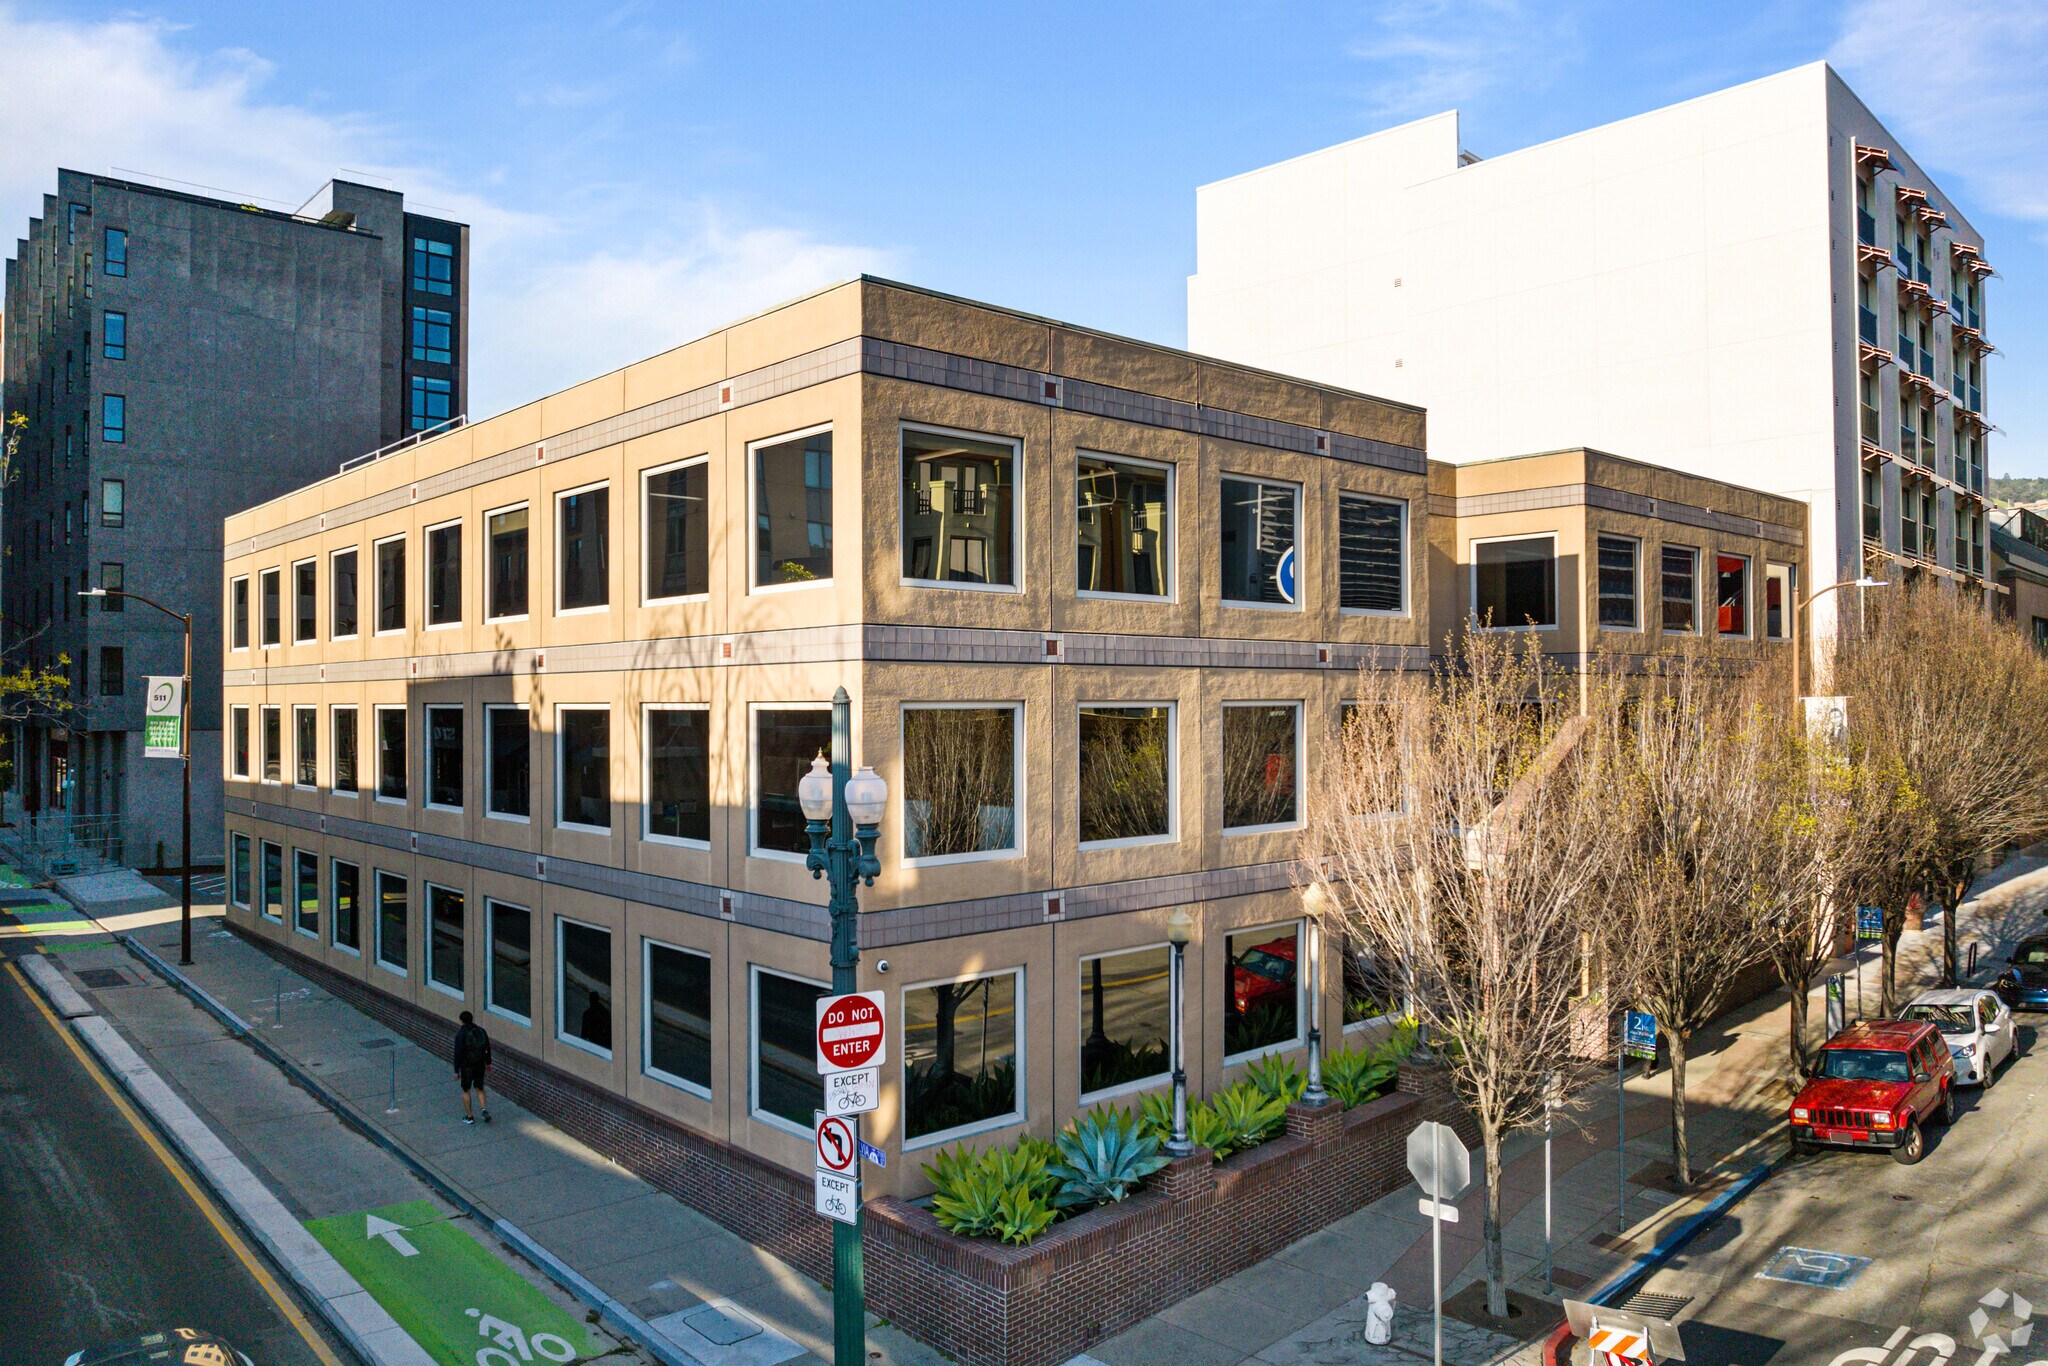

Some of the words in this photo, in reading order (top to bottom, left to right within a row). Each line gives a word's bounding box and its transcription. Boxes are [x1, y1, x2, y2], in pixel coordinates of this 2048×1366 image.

[154, 694, 167, 702] 511
[828, 1011, 845, 1025] DO
[851, 1007, 875, 1021] NOT
[833, 1040, 870, 1057] ENTER
[833, 1072, 870, 1088] EXCEPT
[821, 1176, 850, 1194] EXCEPT
